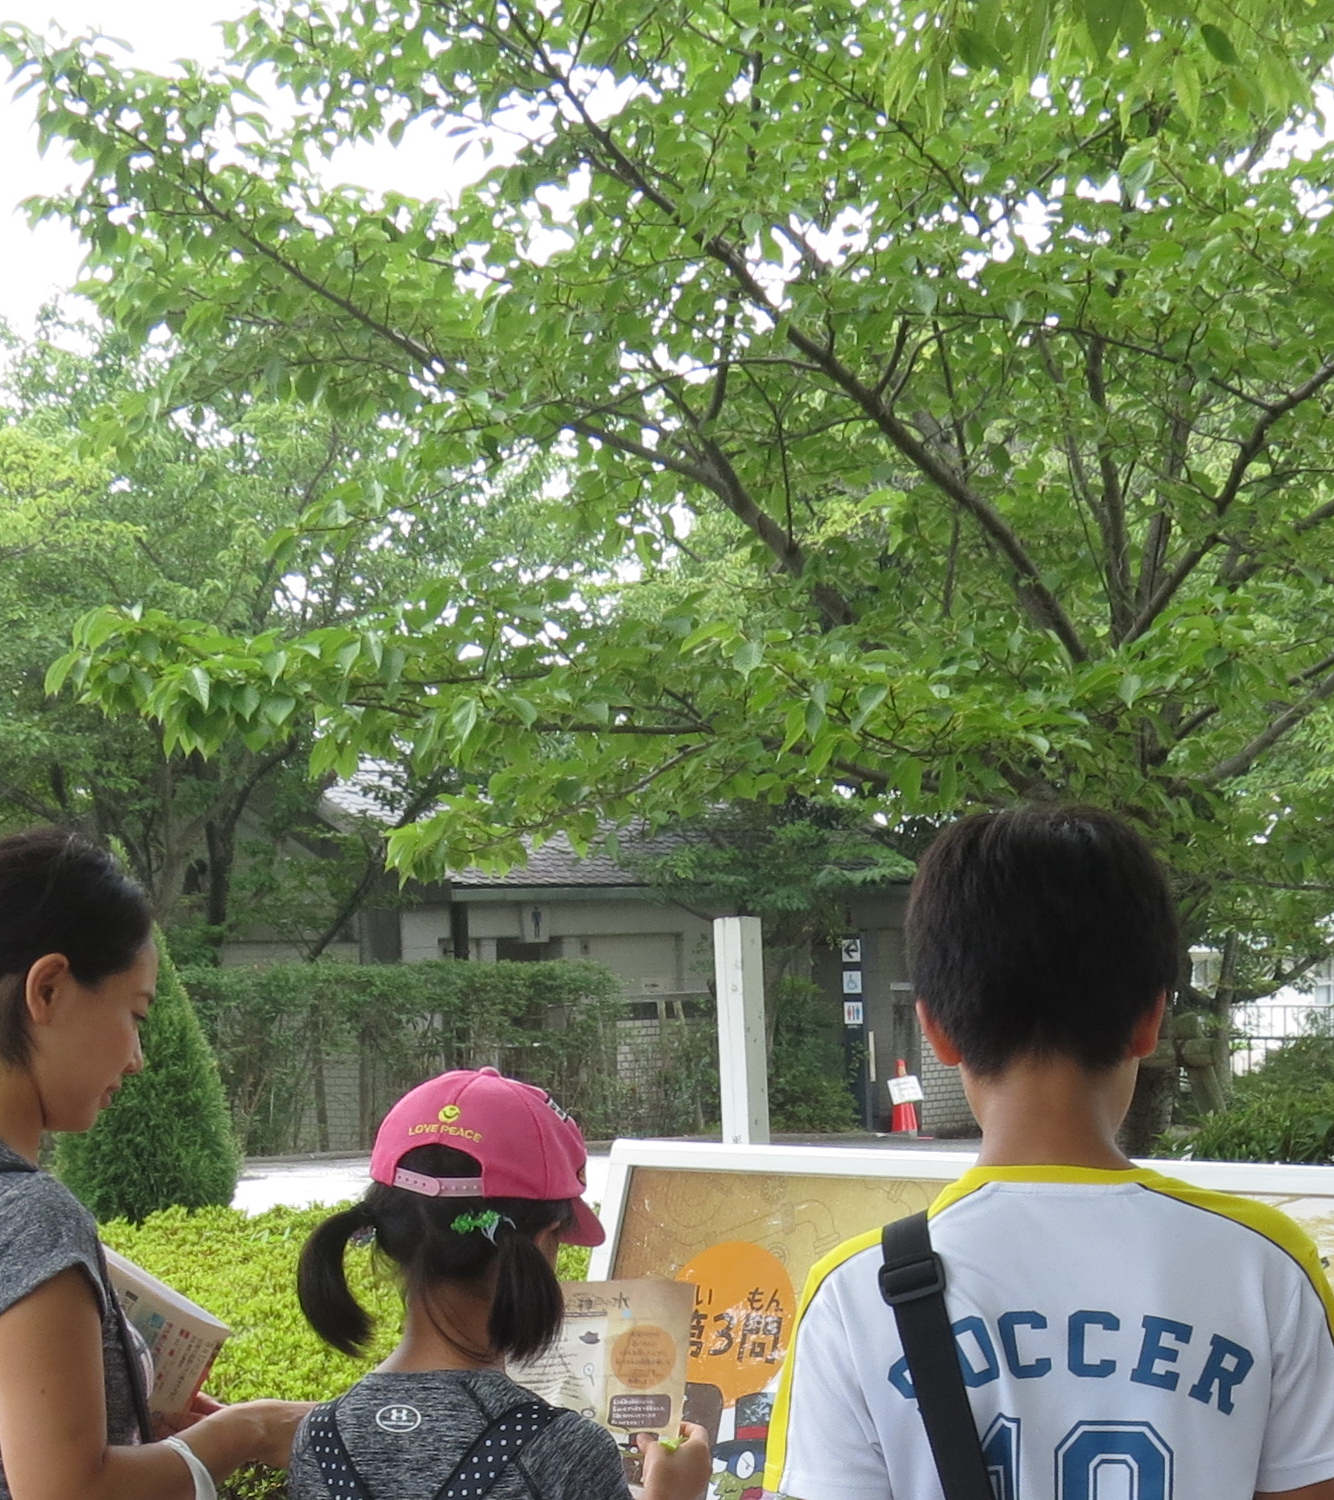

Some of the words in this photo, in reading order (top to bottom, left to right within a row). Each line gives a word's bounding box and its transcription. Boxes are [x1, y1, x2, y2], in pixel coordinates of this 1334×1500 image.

[408, 1124, 439, 1136] LOVE
[440, 1125, 482, 1143] PEACE
[747, 1287, 783, 1312] もん
